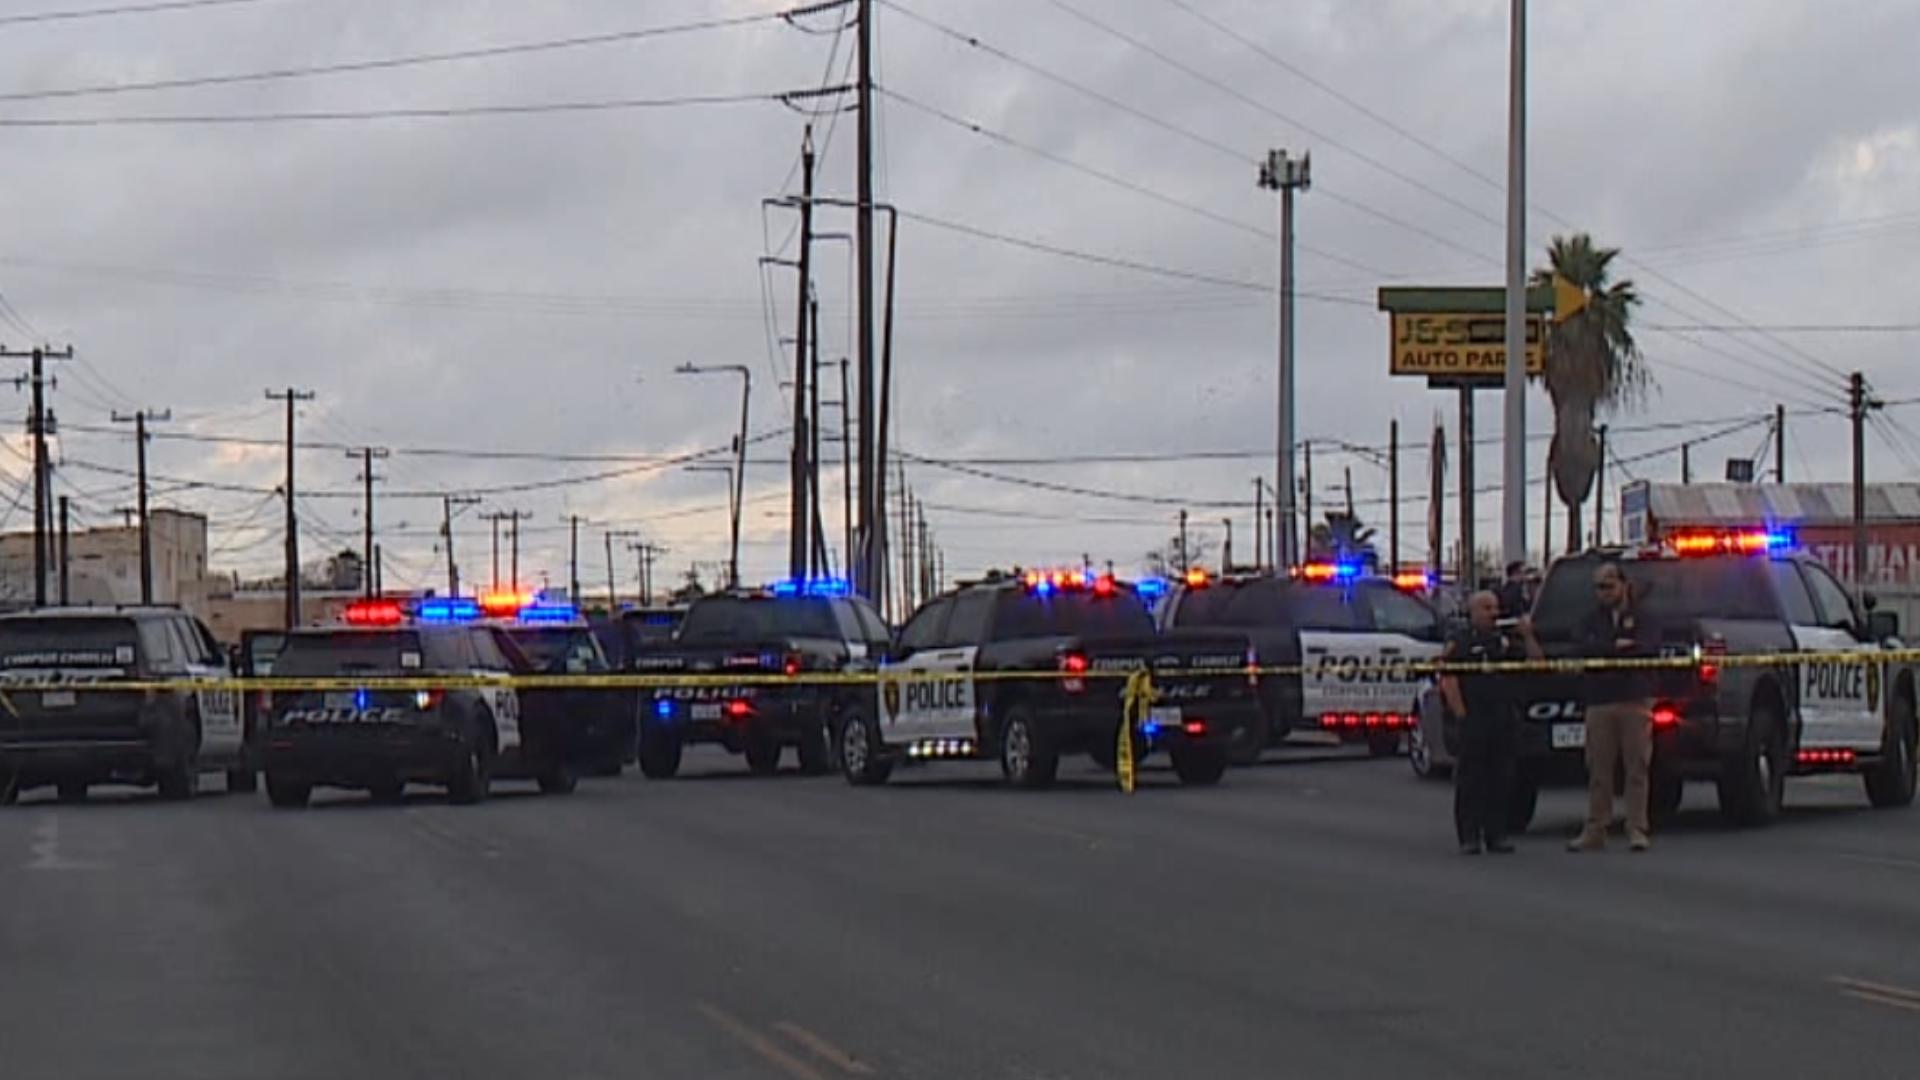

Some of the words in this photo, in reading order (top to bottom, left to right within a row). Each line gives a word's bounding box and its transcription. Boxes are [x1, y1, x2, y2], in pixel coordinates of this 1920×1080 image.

[1402, 351, 1459, 367] AUTO
[1466, 351, 1536, 367] PARS
[1805, 660, 1862, 698] POLICE
[653, 687, 758, 699] POLICE
[907, 680, 966, 713] POLICE
[283, 706, 406, 724] POLICE
